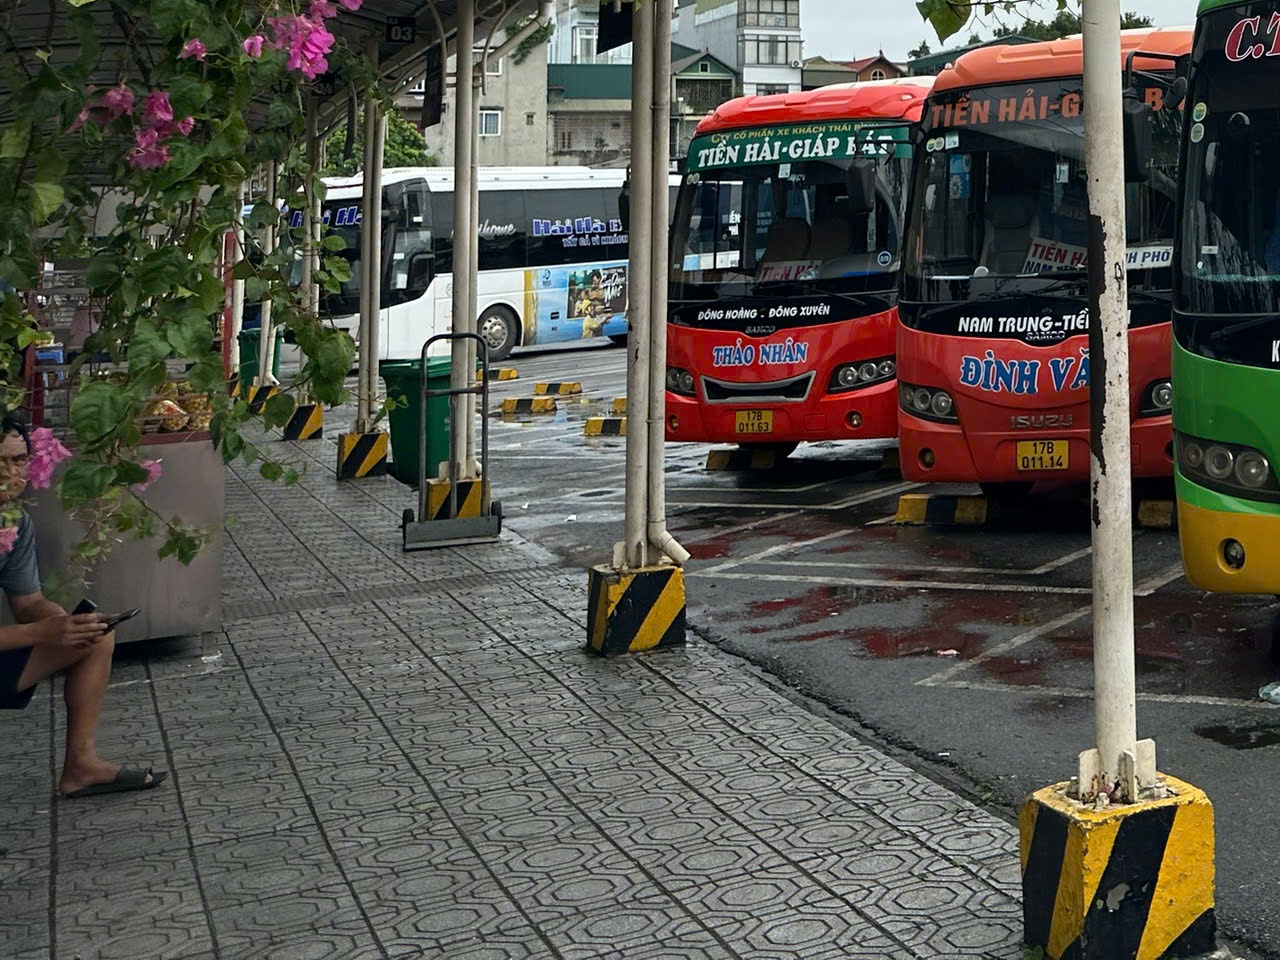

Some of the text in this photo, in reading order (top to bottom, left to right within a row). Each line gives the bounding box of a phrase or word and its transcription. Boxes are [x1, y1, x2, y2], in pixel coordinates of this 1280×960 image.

[391, 26, 413, 41] 03
[777, 128, 790, 136] XE
[792, 123, 826, 135] KHÁCH
[828, 122, 851, 132] THÁI
[698, 140, 739, 167] TIỀN
[1032, 243, 1070, 263] TIỀN
[1141, 248, 1172, 262] PHỐ
[768, 305, 798, 318] ĐÔNG
[800, 303, 831, 316] XUYÊN
[958, 317, 993, 332] NAM
[1025, 331, 1066, 340] SAMCO
[713, 336, 809, 367] THẢO NHÂN
[960, 349, 1041, 395] ĐÌNH
[747, 411, 762, 421] 17B
[1010, 415, 1073, 428] ISUZU
[738, 422, 769, 432] 011.63
[1033, 443, 1054, 454] 17B
[1022, 456, 1063, 469] 011.14
